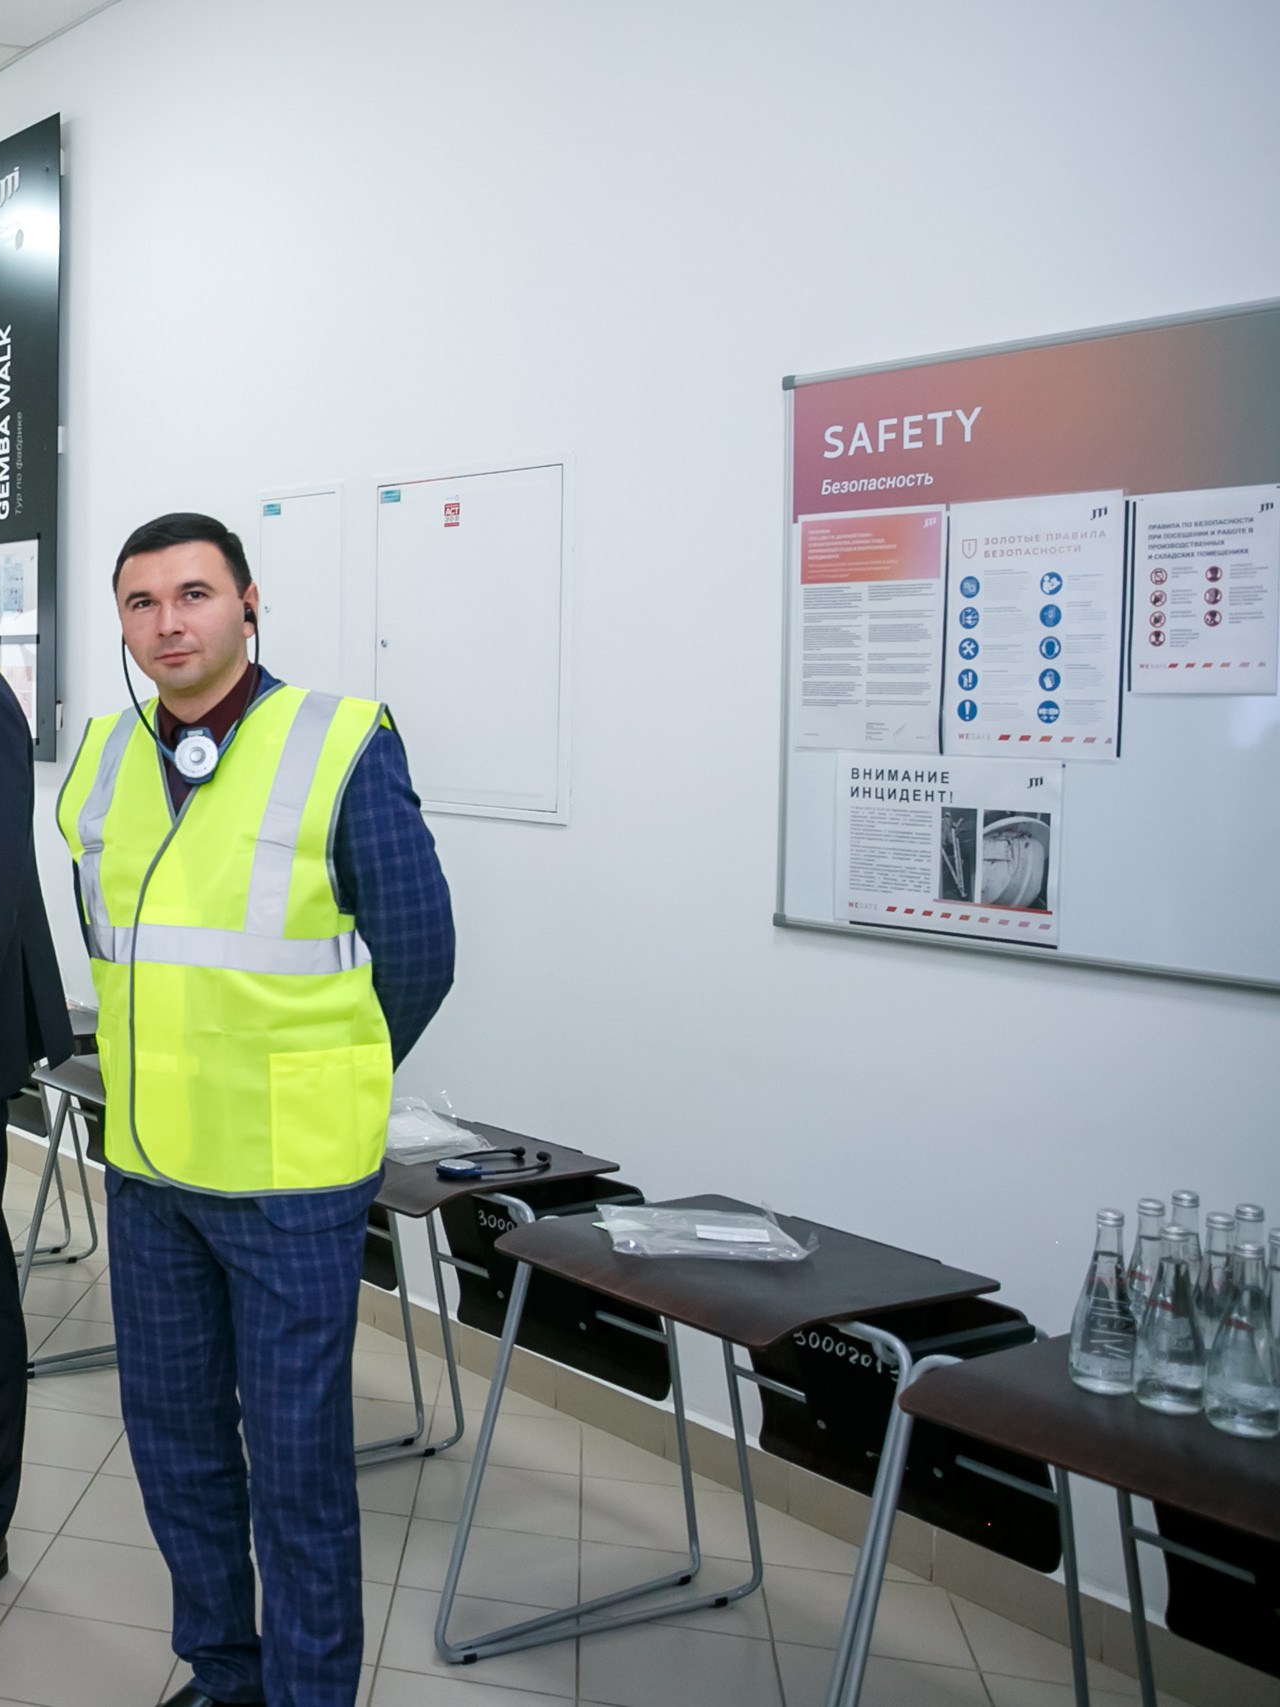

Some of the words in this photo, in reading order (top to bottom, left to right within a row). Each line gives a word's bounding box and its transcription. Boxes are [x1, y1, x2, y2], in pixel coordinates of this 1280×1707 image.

[15, 411, 24, 470] фабрике
[823, 406, 983, 459] SAFETY
[16, 473, 23, 490] по
[820, 472, 934, 496] Безопасность
[14, 493, 24, 516] Тур
[1193, 517, 1254, 527] БЕЗОПАСНОСТИ
[983, 533, 1041, 546] ЗОЛОТЫЕ
[1046, 530, 1106, 541] ПРАВИЛА
[1163, 531, 1209, 540] ПОСЕЩЕНИИ
[1217, 528, 1246, 536] РАБОТЕ
[983, 545, 1082, 559] БЕЗОПАСНОСТИ
[1148, 539, 1225, 550] ПРОИЗВОДСТВЕННЫХ
[1154, 551, 1195, 560] СКЛАДСКИХ
[1196, 548, 1249, 557] ПОМЕЩЕНИЯХ
[850, 767, 950, 784] ВНИМАНИЕ
[850, 785, 954, 804] ИНЦИДЕНТ!
